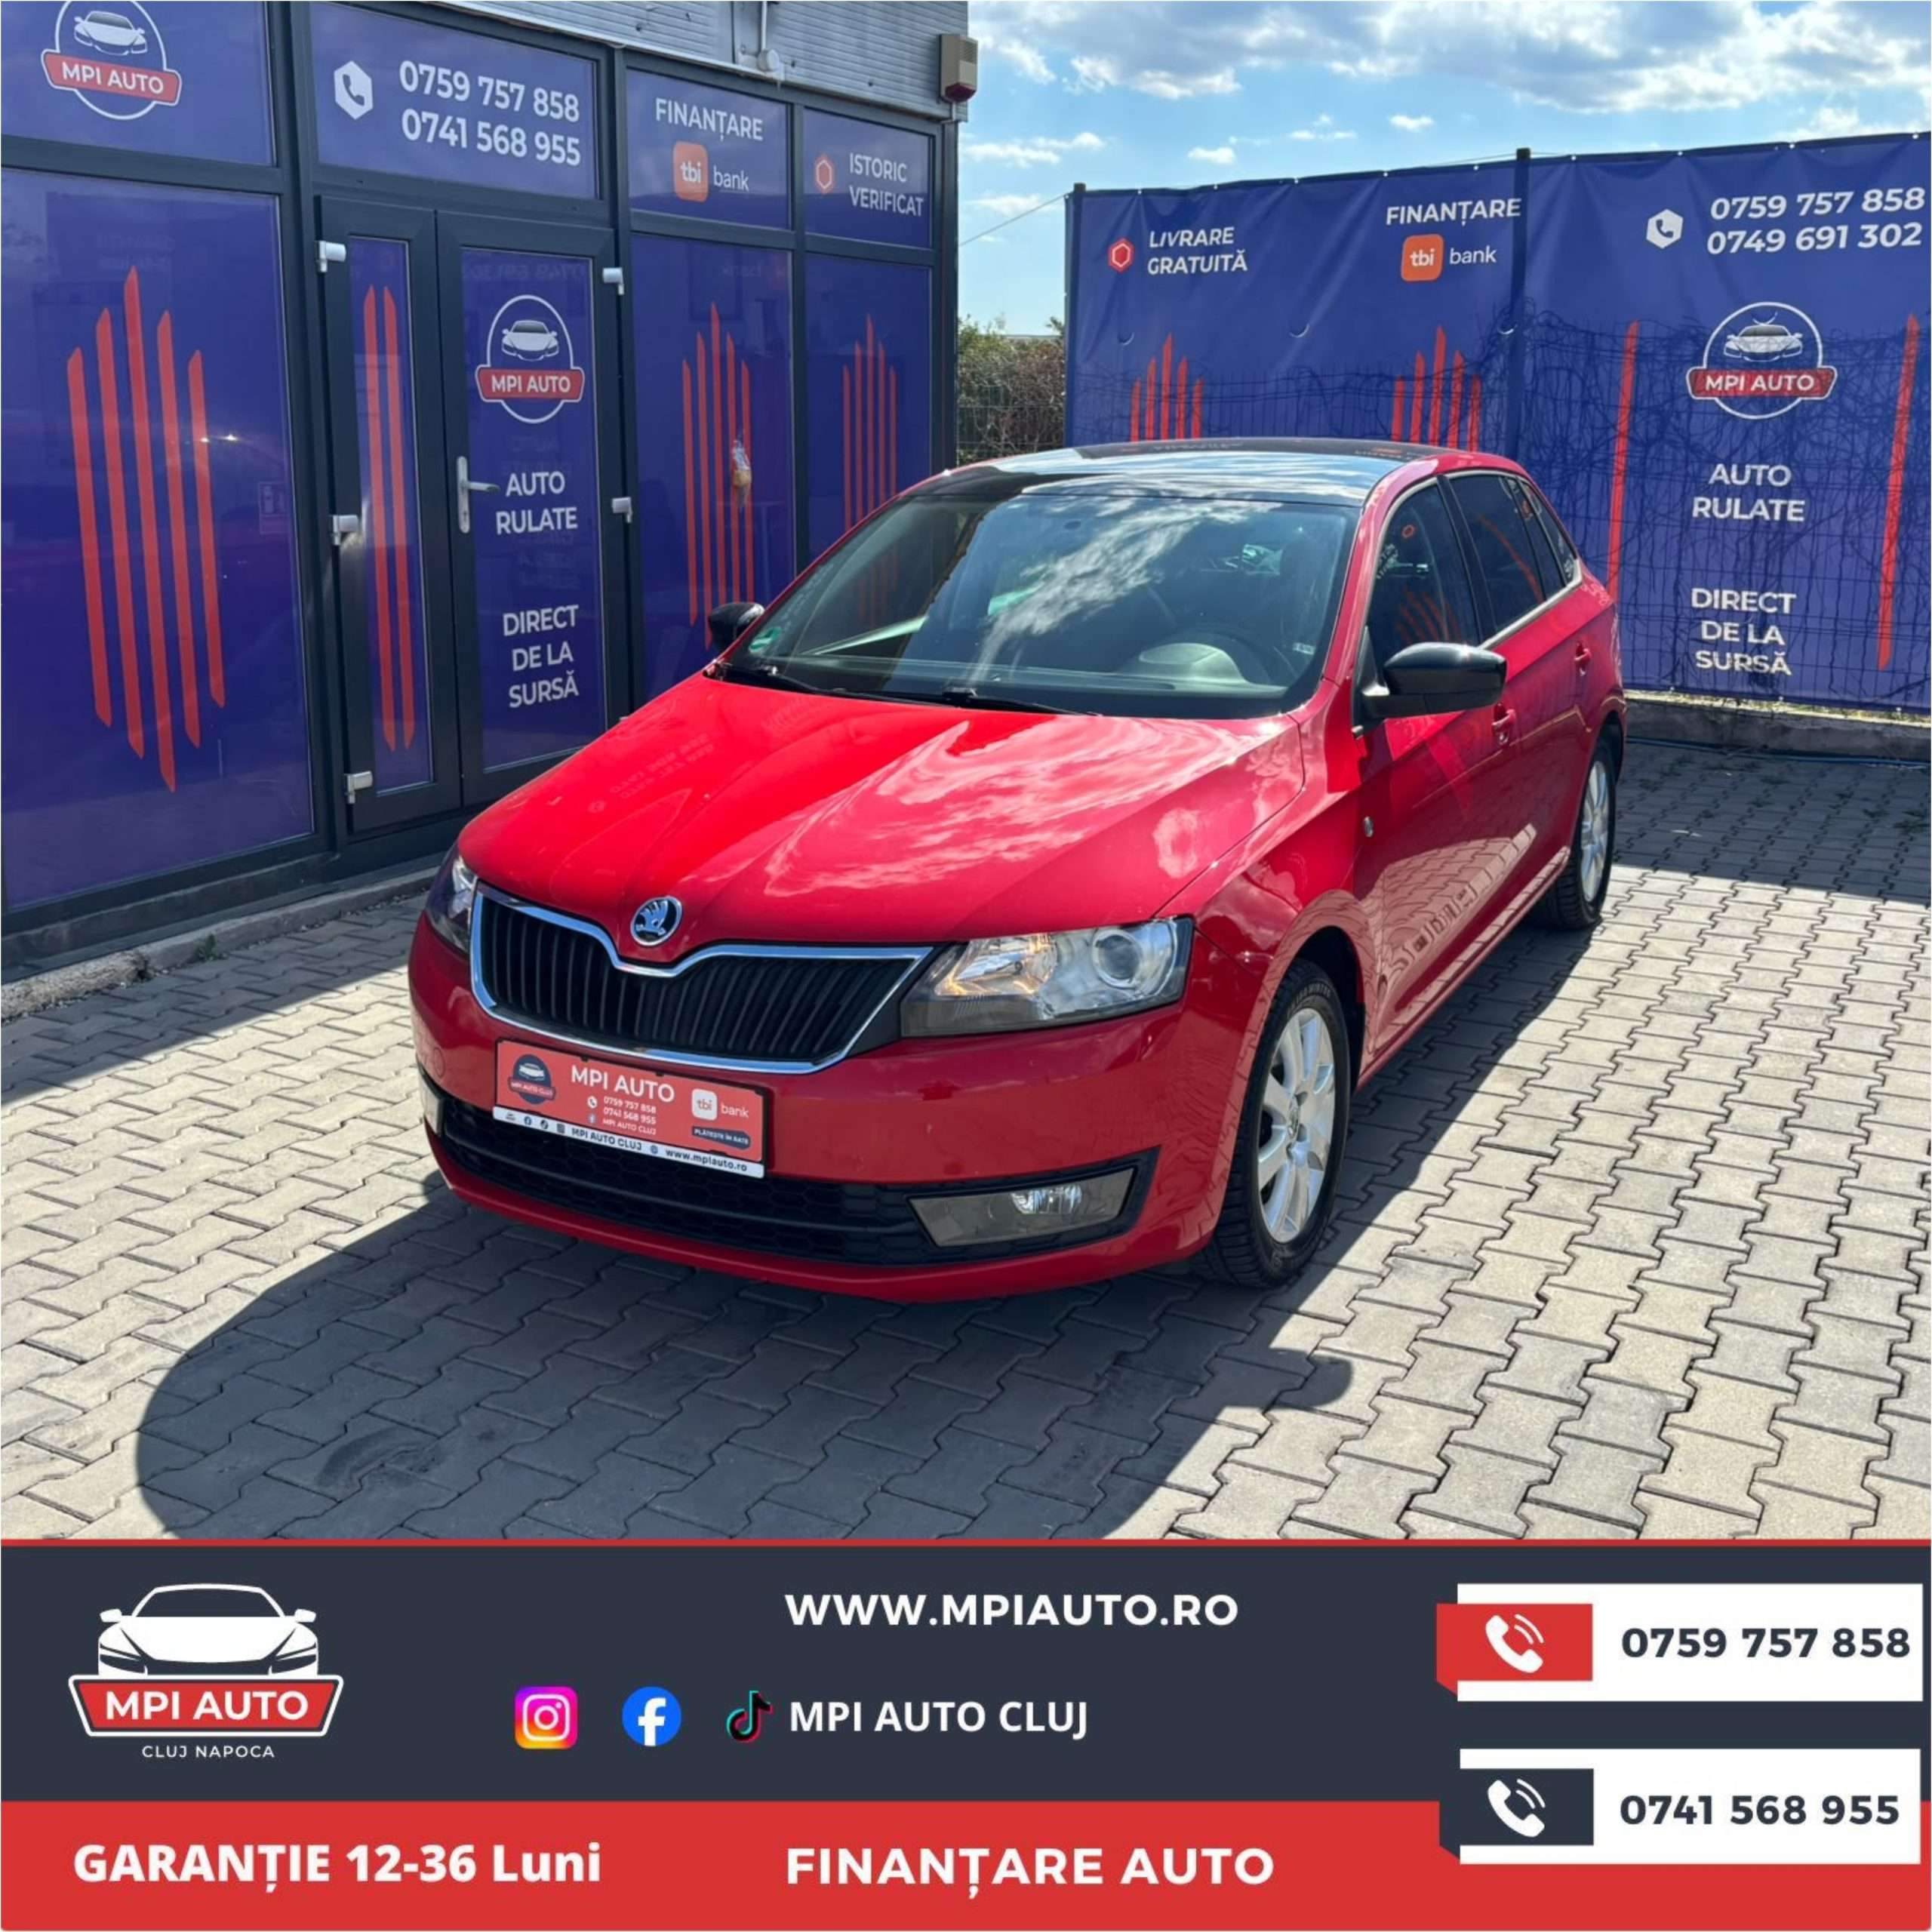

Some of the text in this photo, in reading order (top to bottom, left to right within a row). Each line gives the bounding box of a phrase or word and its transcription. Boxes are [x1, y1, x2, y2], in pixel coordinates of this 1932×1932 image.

[62, 61, 165, 94] MPI AUTO
[399, 60, 580, 122] 0759 757 858
[656, 97, 763, 141] FINANȚARE
[401, 108, 580, 166] 0741 568 955
[680, 161, 749, 192] tbi bank
[850, 152, 907, 183] ISTORIC
[848, 184, 924, 216] VERIFICAT
[1386, 198, 1521, 226] FINANȚARE
[1710, 186, 1925, 220] 0759 757 858
[1149, 226, 1235, 248] LIVRARE
[1707, 222, 1922, 254] 0749 691 302
[1147, 249, 1247, 275] GRATUITĂ
[1410, 245, 1497, 266] tbi bank
[491, 375, 571, 393] MPI AUTO
[1706, 374, 1815, 391] MPI AUTO
[506, 471, 565, 497] AUTO
[1709, 463, 1792, 487] AUTO
[496, 506, 578, 534] RULATE
[1692, 497, 1805, 521] RULATE
[1691, 587, 1797, 614] DIRECT
[503, 605, 579, 636] DIRECT
[1701, 620, 1786, 646] DE LA
[512, 641, 574, 672] DE LA
[1695, 650, 1792, 675] SURSĂ
[509, 669, 579, 708] SURSĂ
[571, 1065, 675, 1103] MPI AUTO
[697, 1097, 750, 1118] tbi bank
[571, 1127, 642, 1151] MPI AUTO CLUJ
